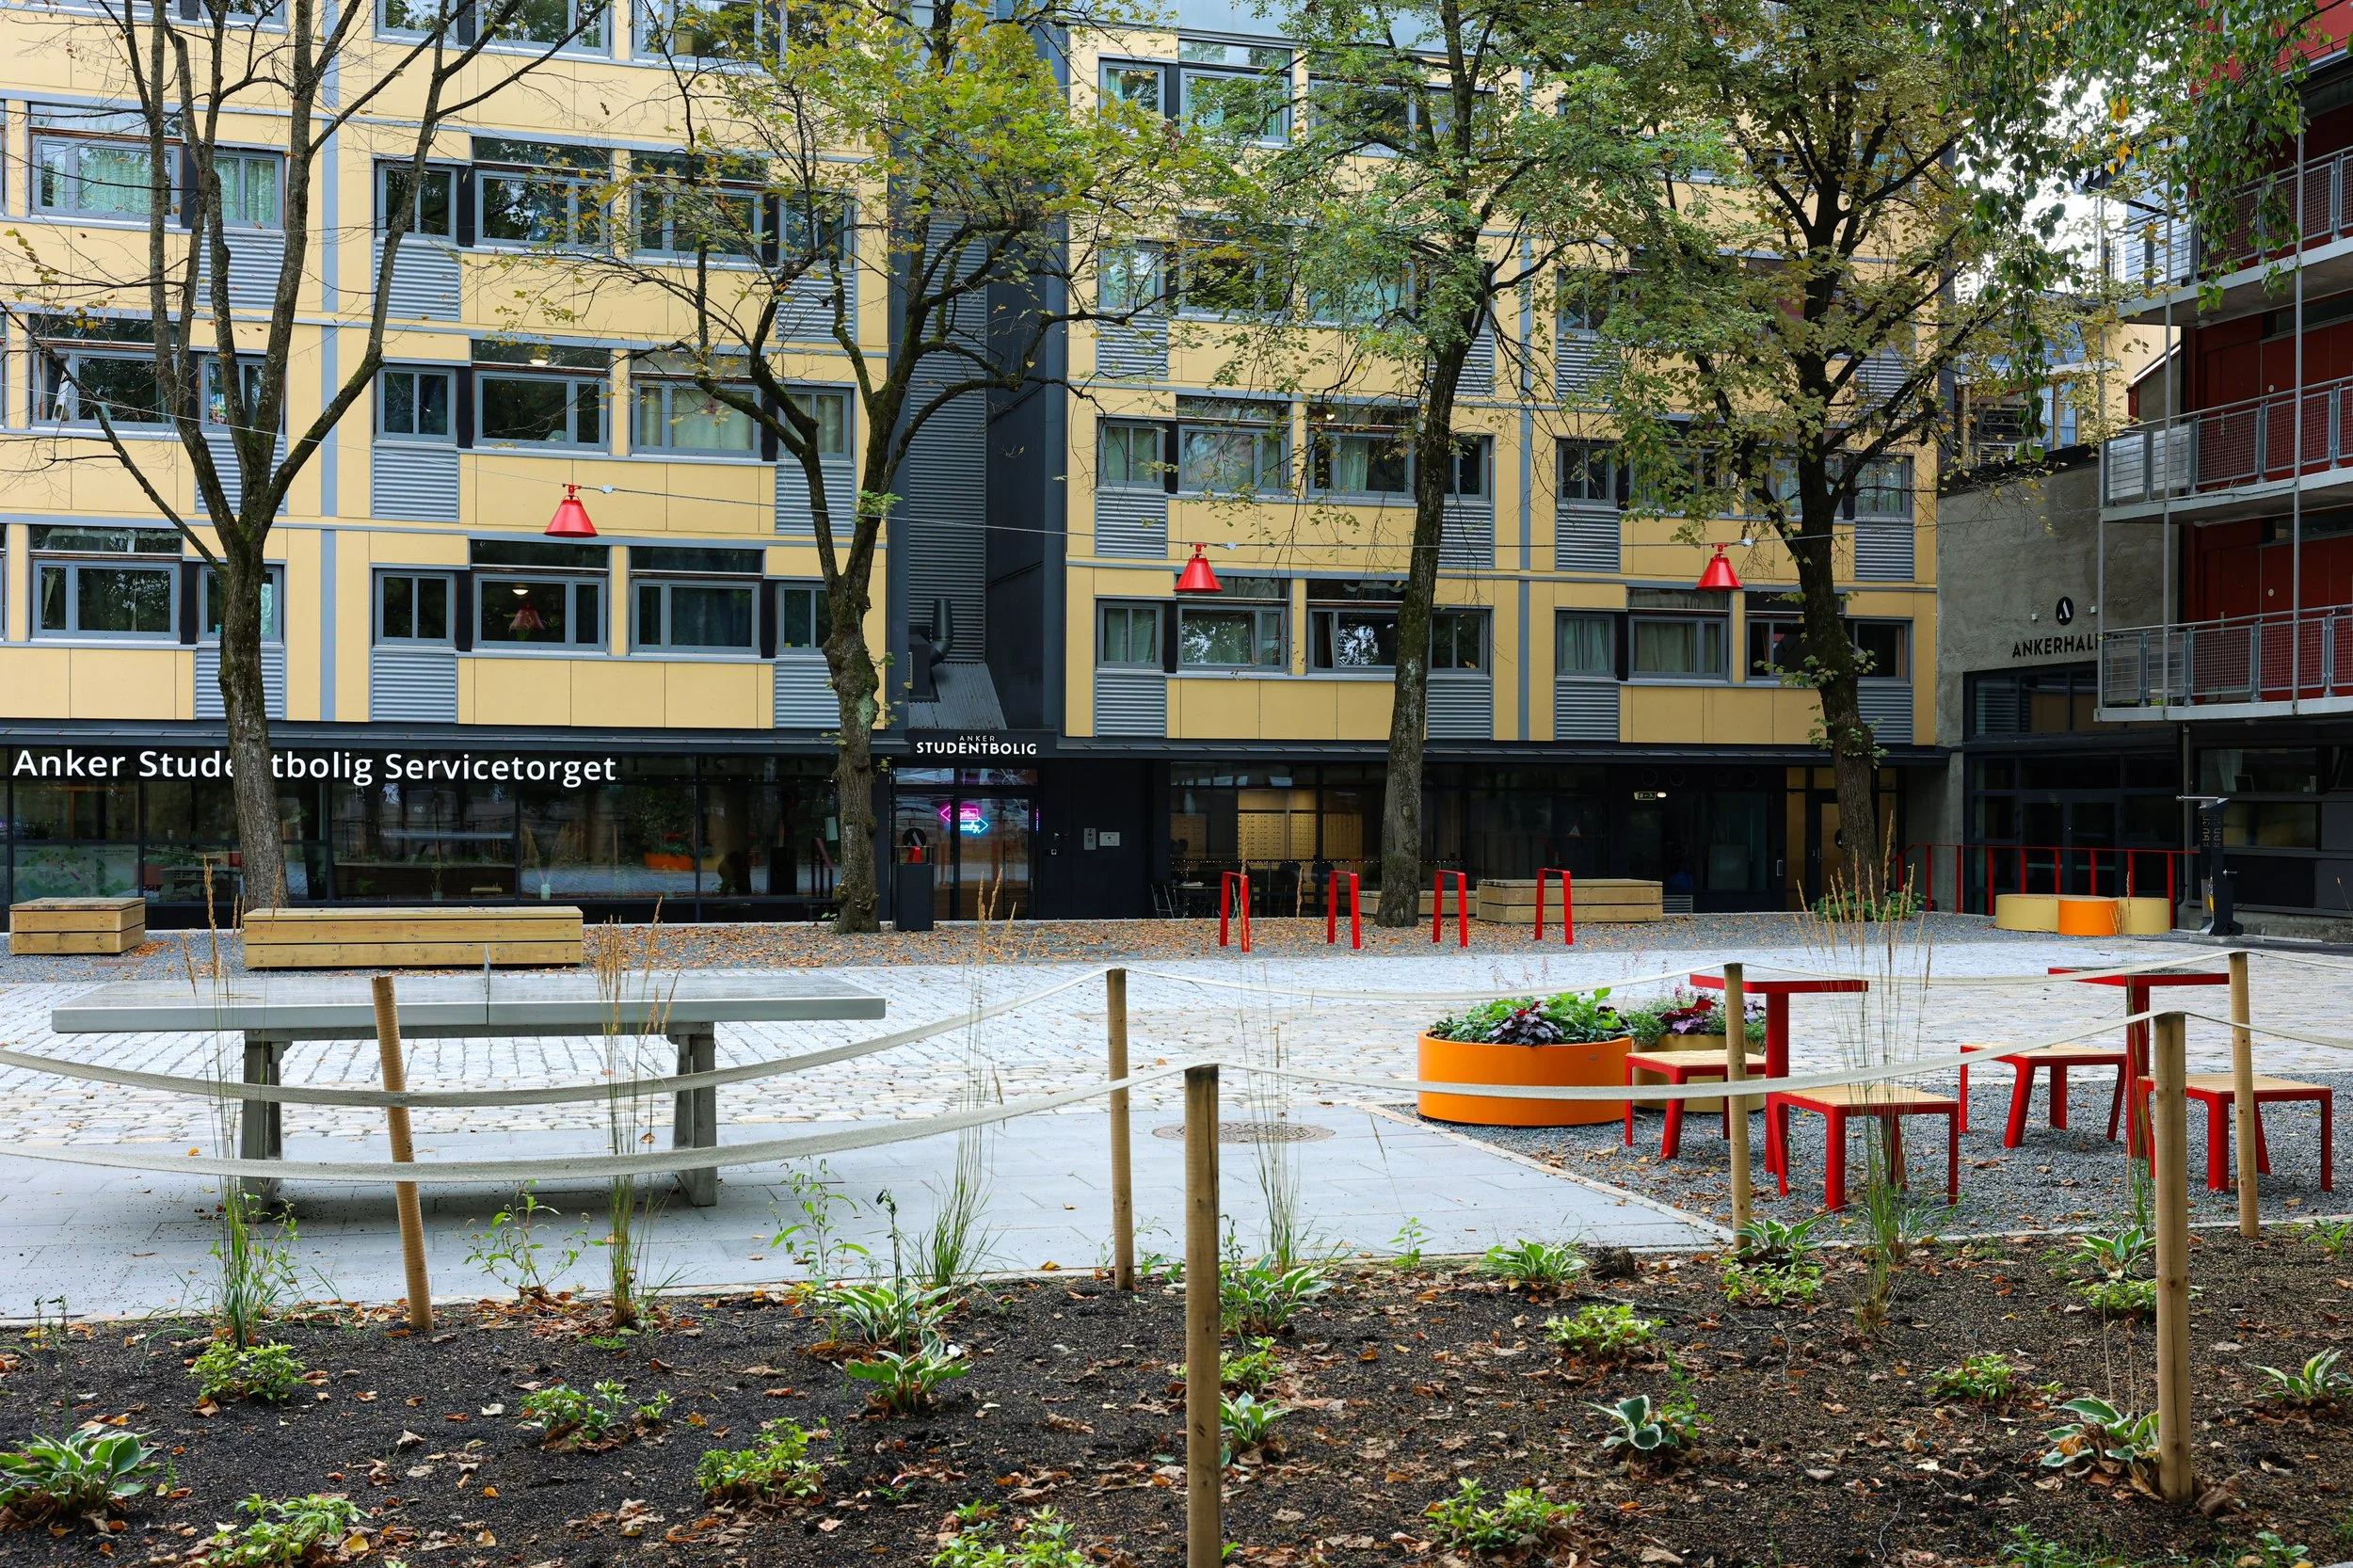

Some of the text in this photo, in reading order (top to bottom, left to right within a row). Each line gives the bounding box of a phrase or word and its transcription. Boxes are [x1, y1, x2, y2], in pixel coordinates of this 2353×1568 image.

[2012, 632, 2123, 658] ANKERHALL
[916, 742, 1037, 755] STUDENTBOLIG
[12, 749, 617, 789] Anker Studtbolig Servicetorget
